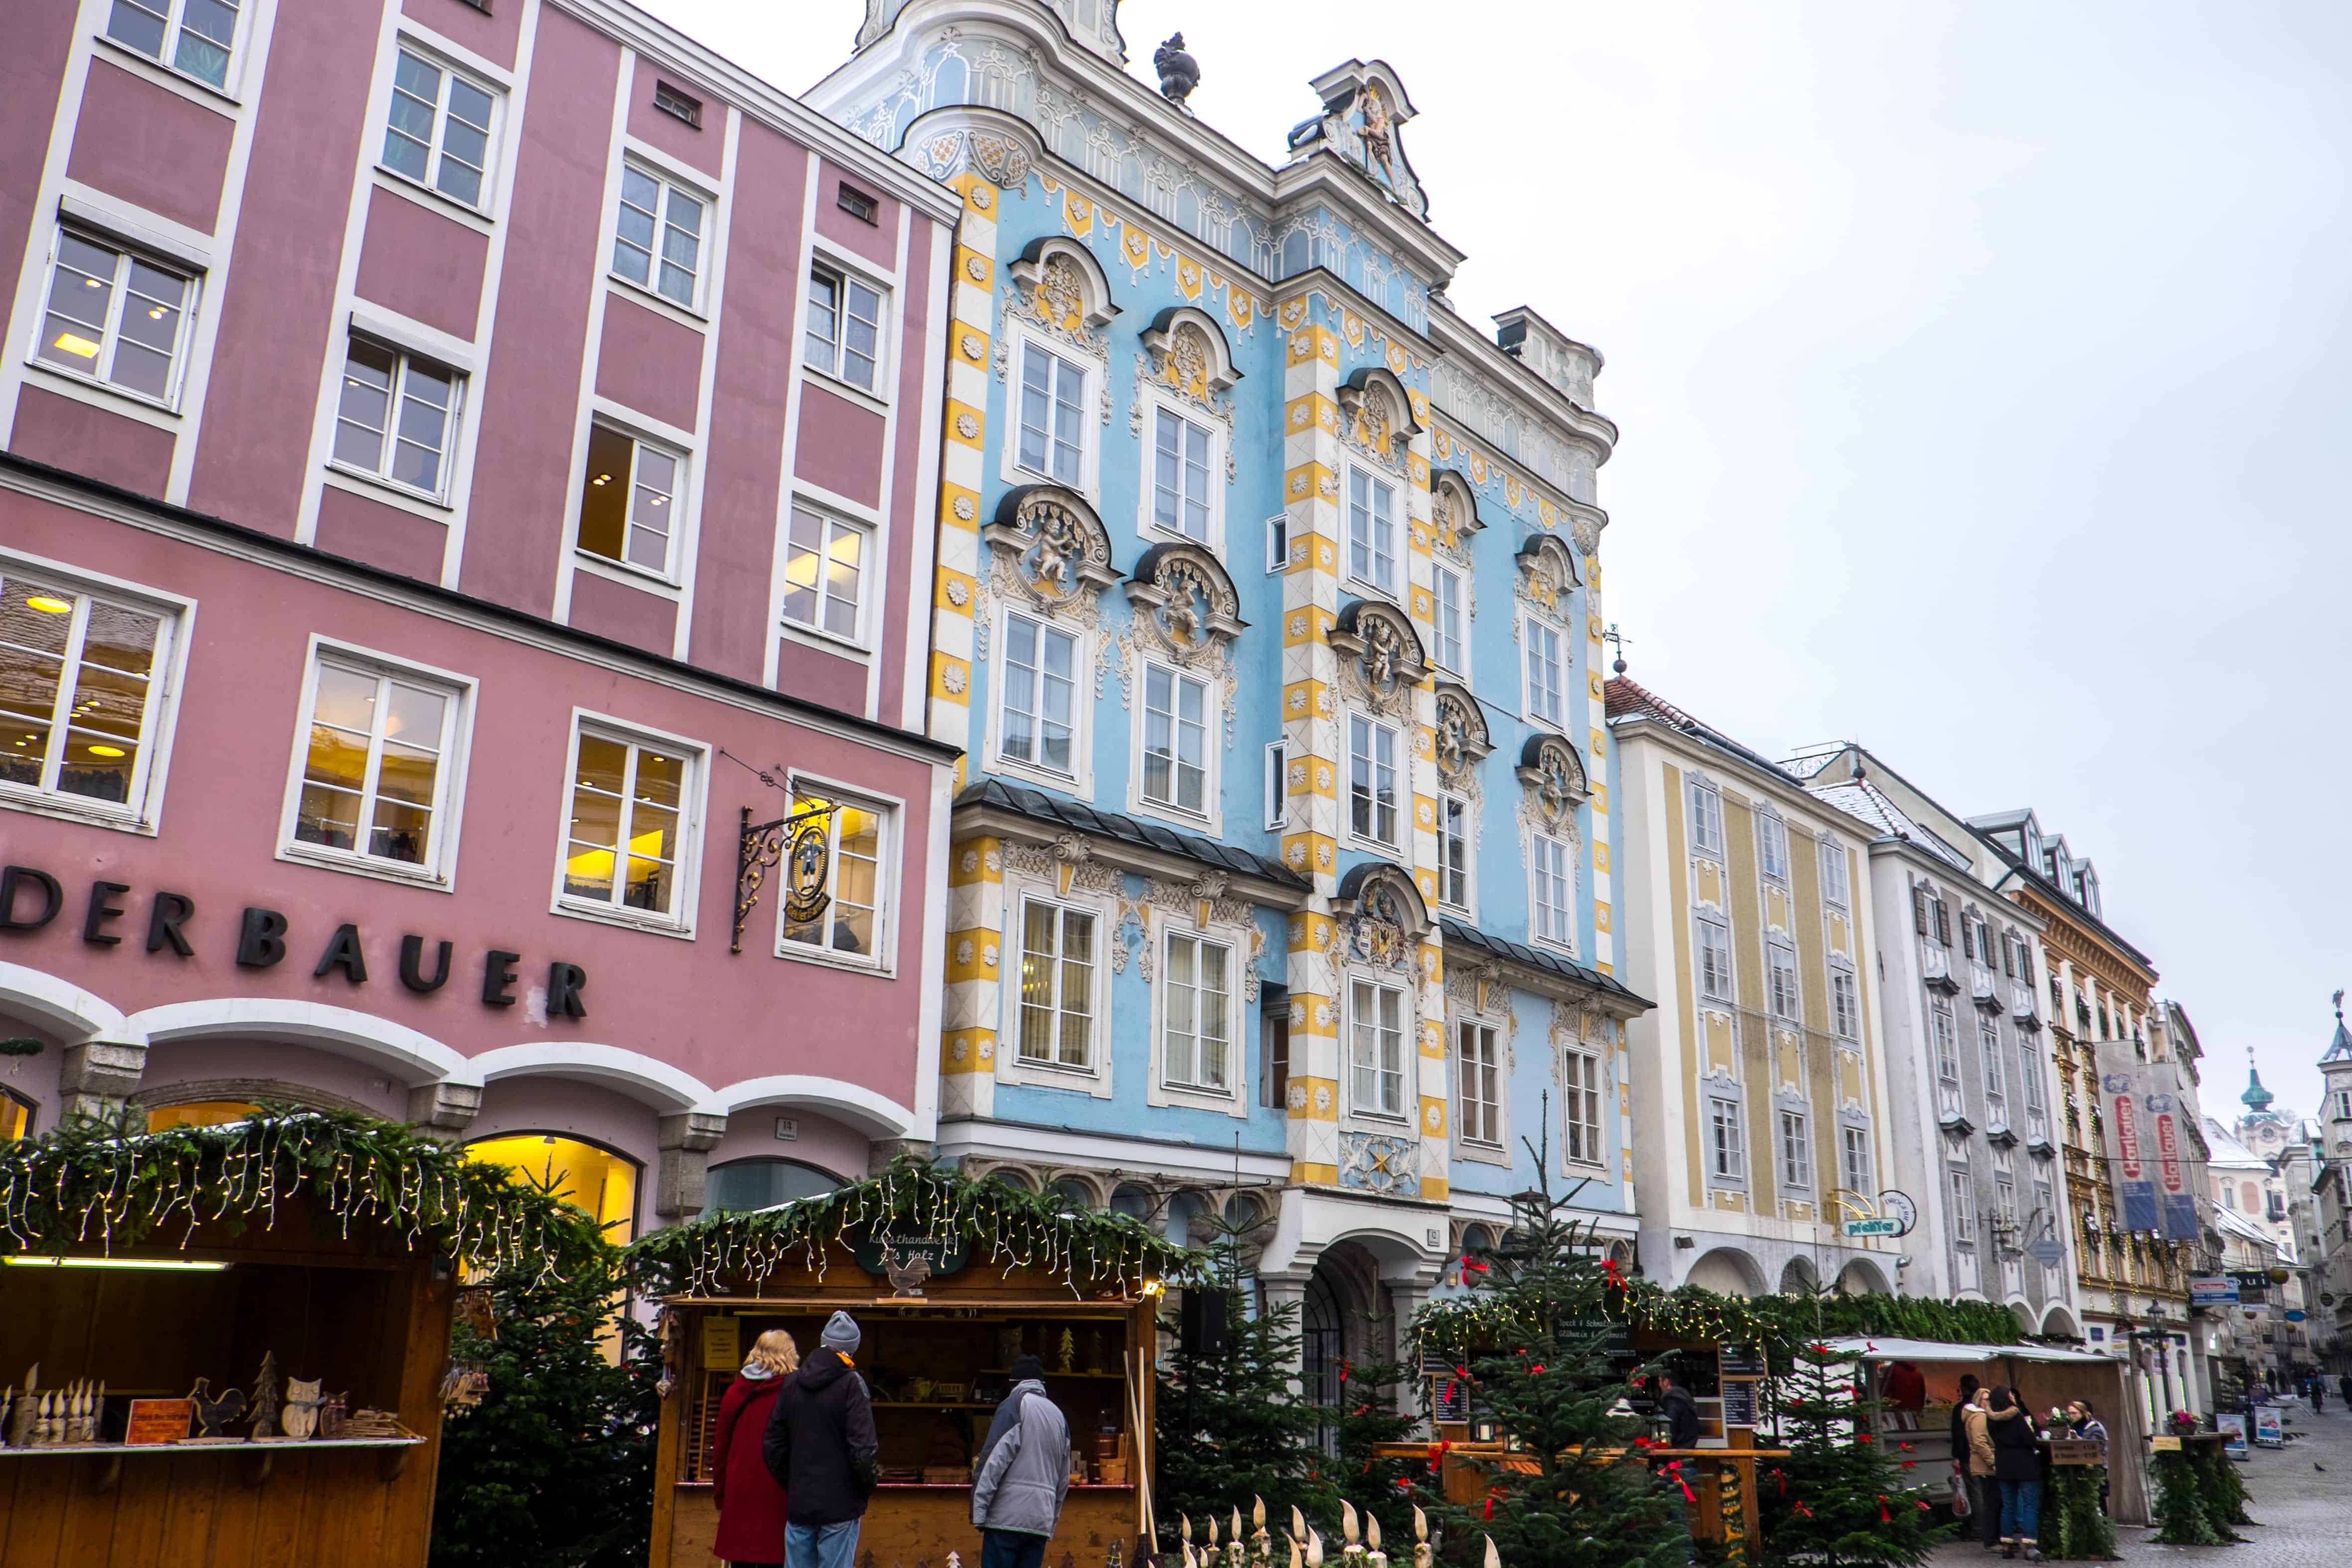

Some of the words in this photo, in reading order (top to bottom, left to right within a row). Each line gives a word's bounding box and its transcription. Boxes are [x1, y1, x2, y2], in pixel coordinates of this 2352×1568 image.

[237, 907, 588, 1017] BAUER
[2120, 1101, 2140, 1172] Hartlauer
[2162, 1121, 2180, 1186] Hartlauer
[881, 1251, 900, 1260] as
[907, 1250, 935, 1260] Holz
[1559, 1319, 1576, 1327] Speck
